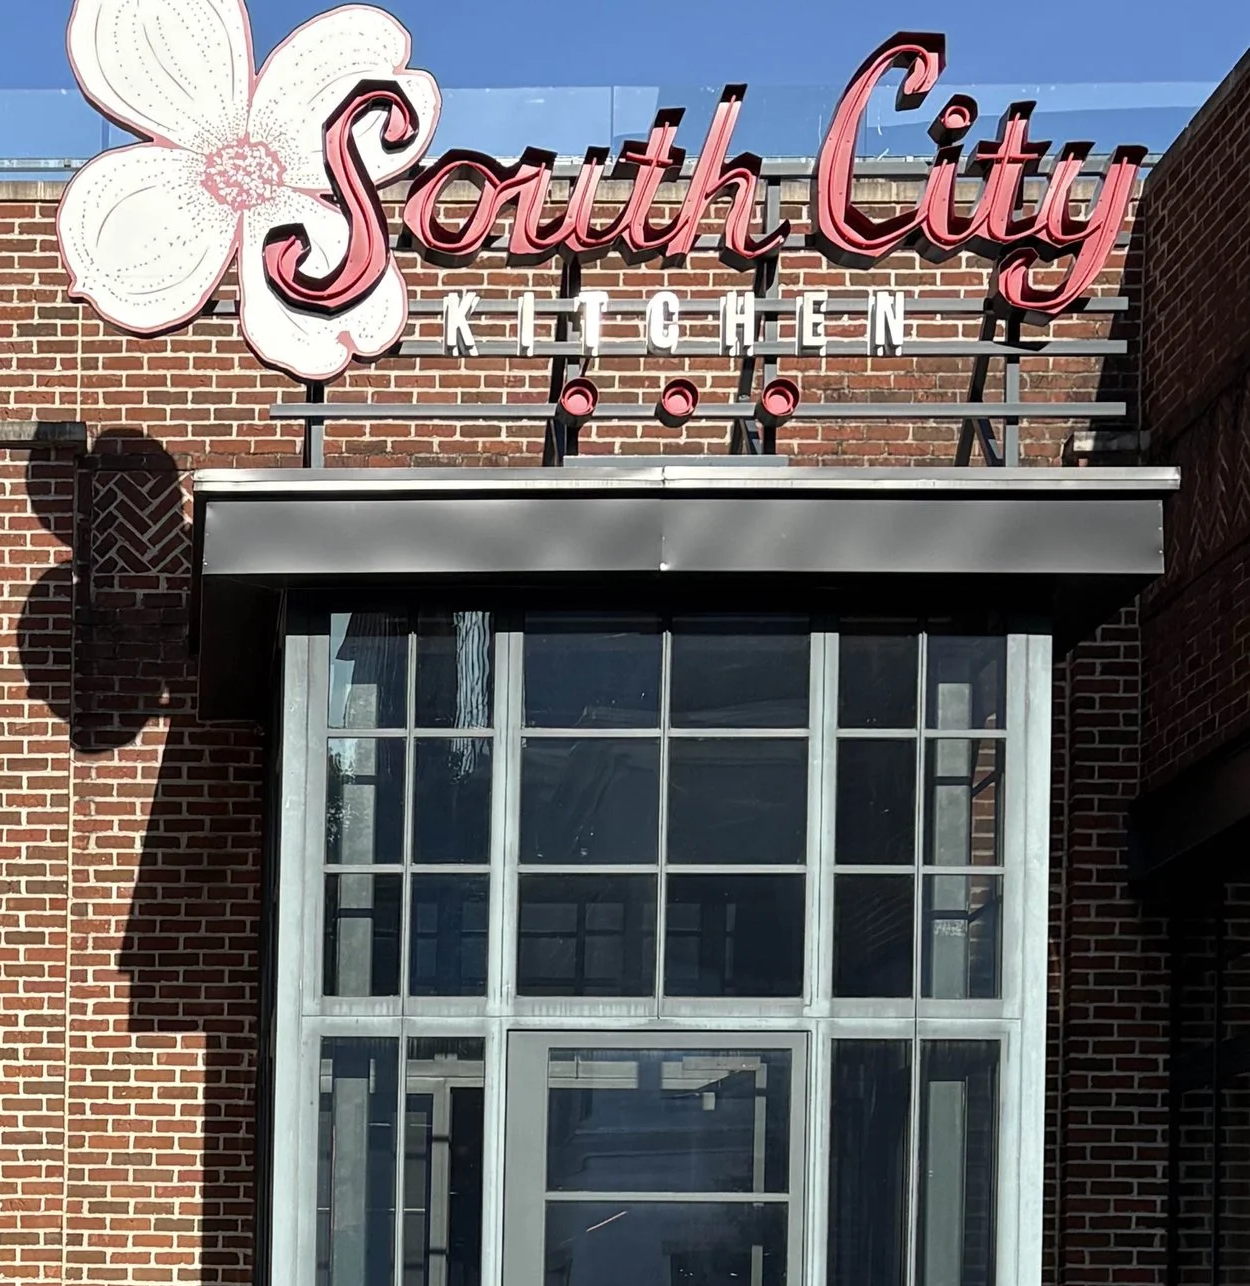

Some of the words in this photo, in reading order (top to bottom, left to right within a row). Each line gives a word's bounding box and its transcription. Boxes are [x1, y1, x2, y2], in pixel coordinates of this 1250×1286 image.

[263, 80, 790, 314] South
[814, 31, 1148, 319] City
[446, 290, 905, 357] KITCHEN
